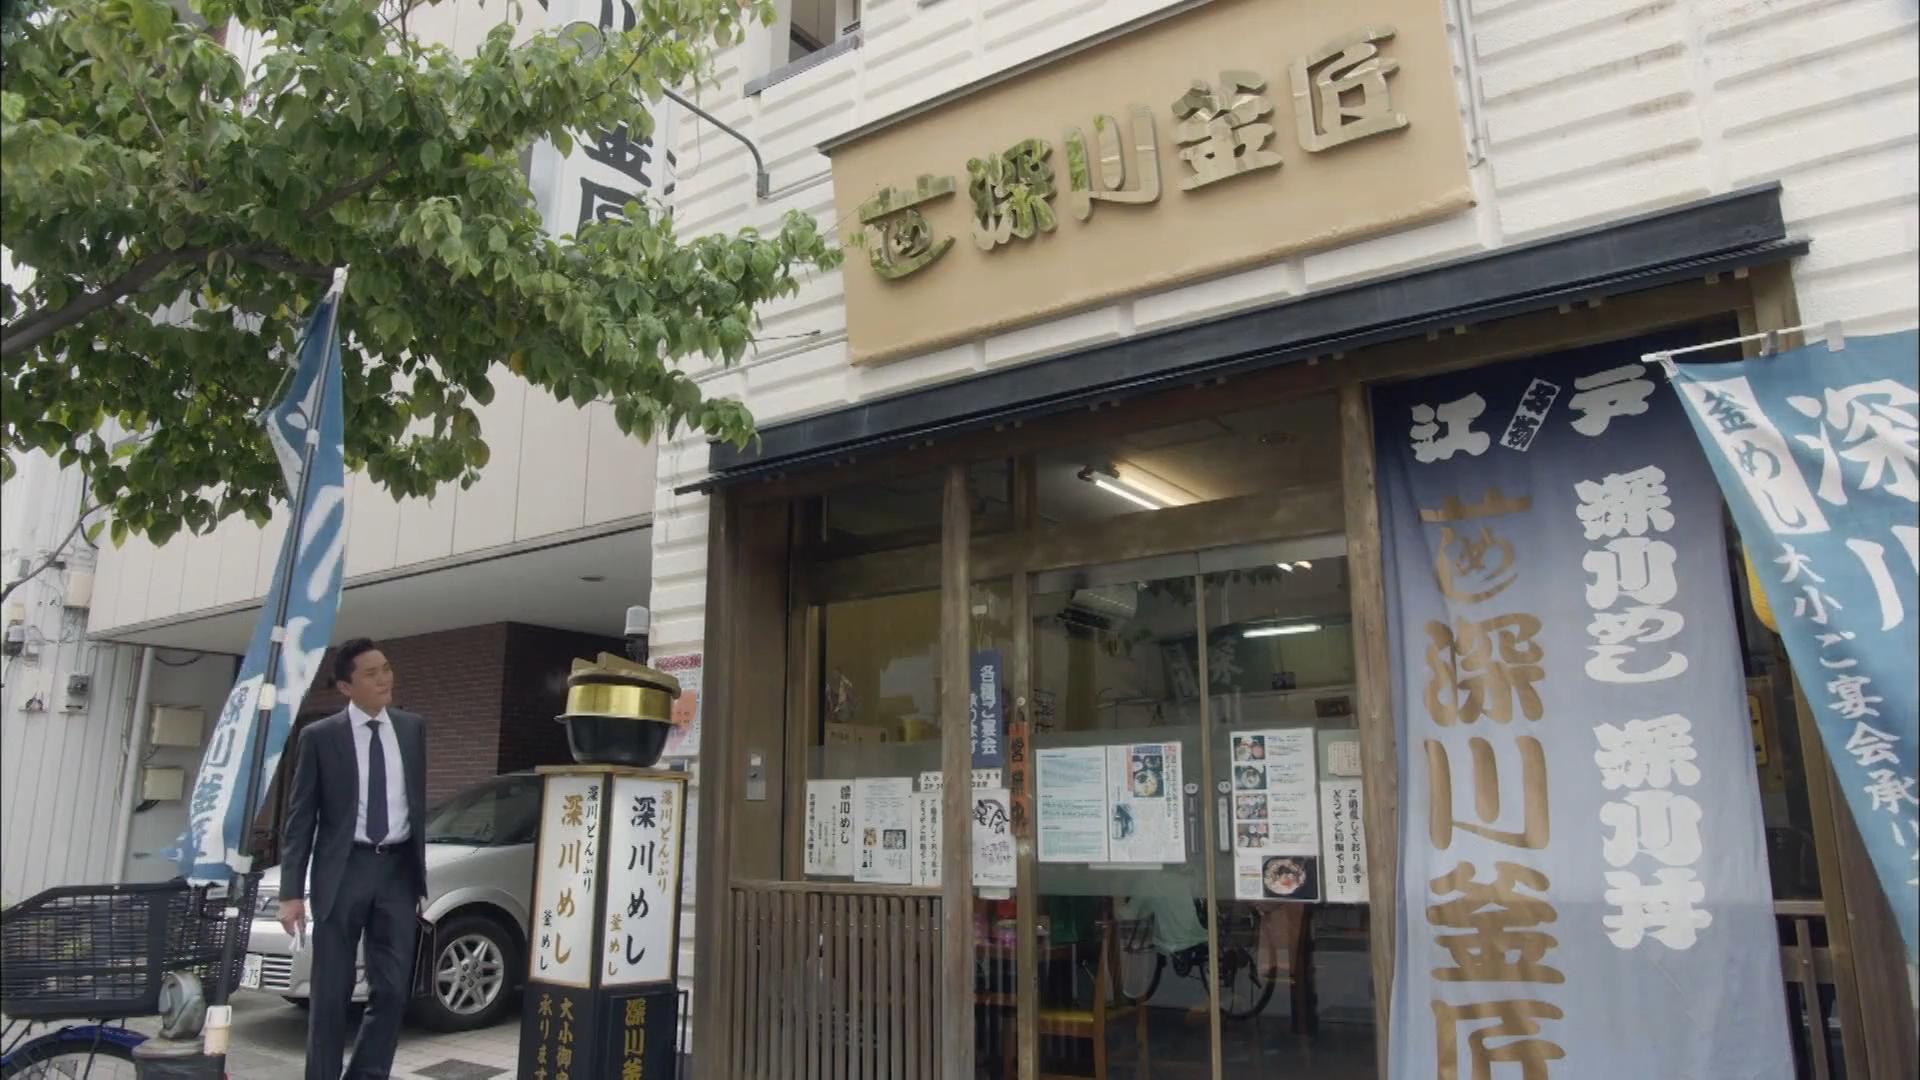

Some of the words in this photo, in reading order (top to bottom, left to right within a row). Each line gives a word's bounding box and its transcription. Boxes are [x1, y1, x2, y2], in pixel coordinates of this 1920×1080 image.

[1702, 388, 1807, 530] 釜めし
[1574, 465, 1689, 684] 深川めし
[554, 794, 584, 966] 深川めし
[625, 795, 658, 966] 深川めし
[1593, 713, 1713, 950] 深川丼
[539, 909, 553, 971] 釜めし
[607, 912, 623, 977] 釜めし
